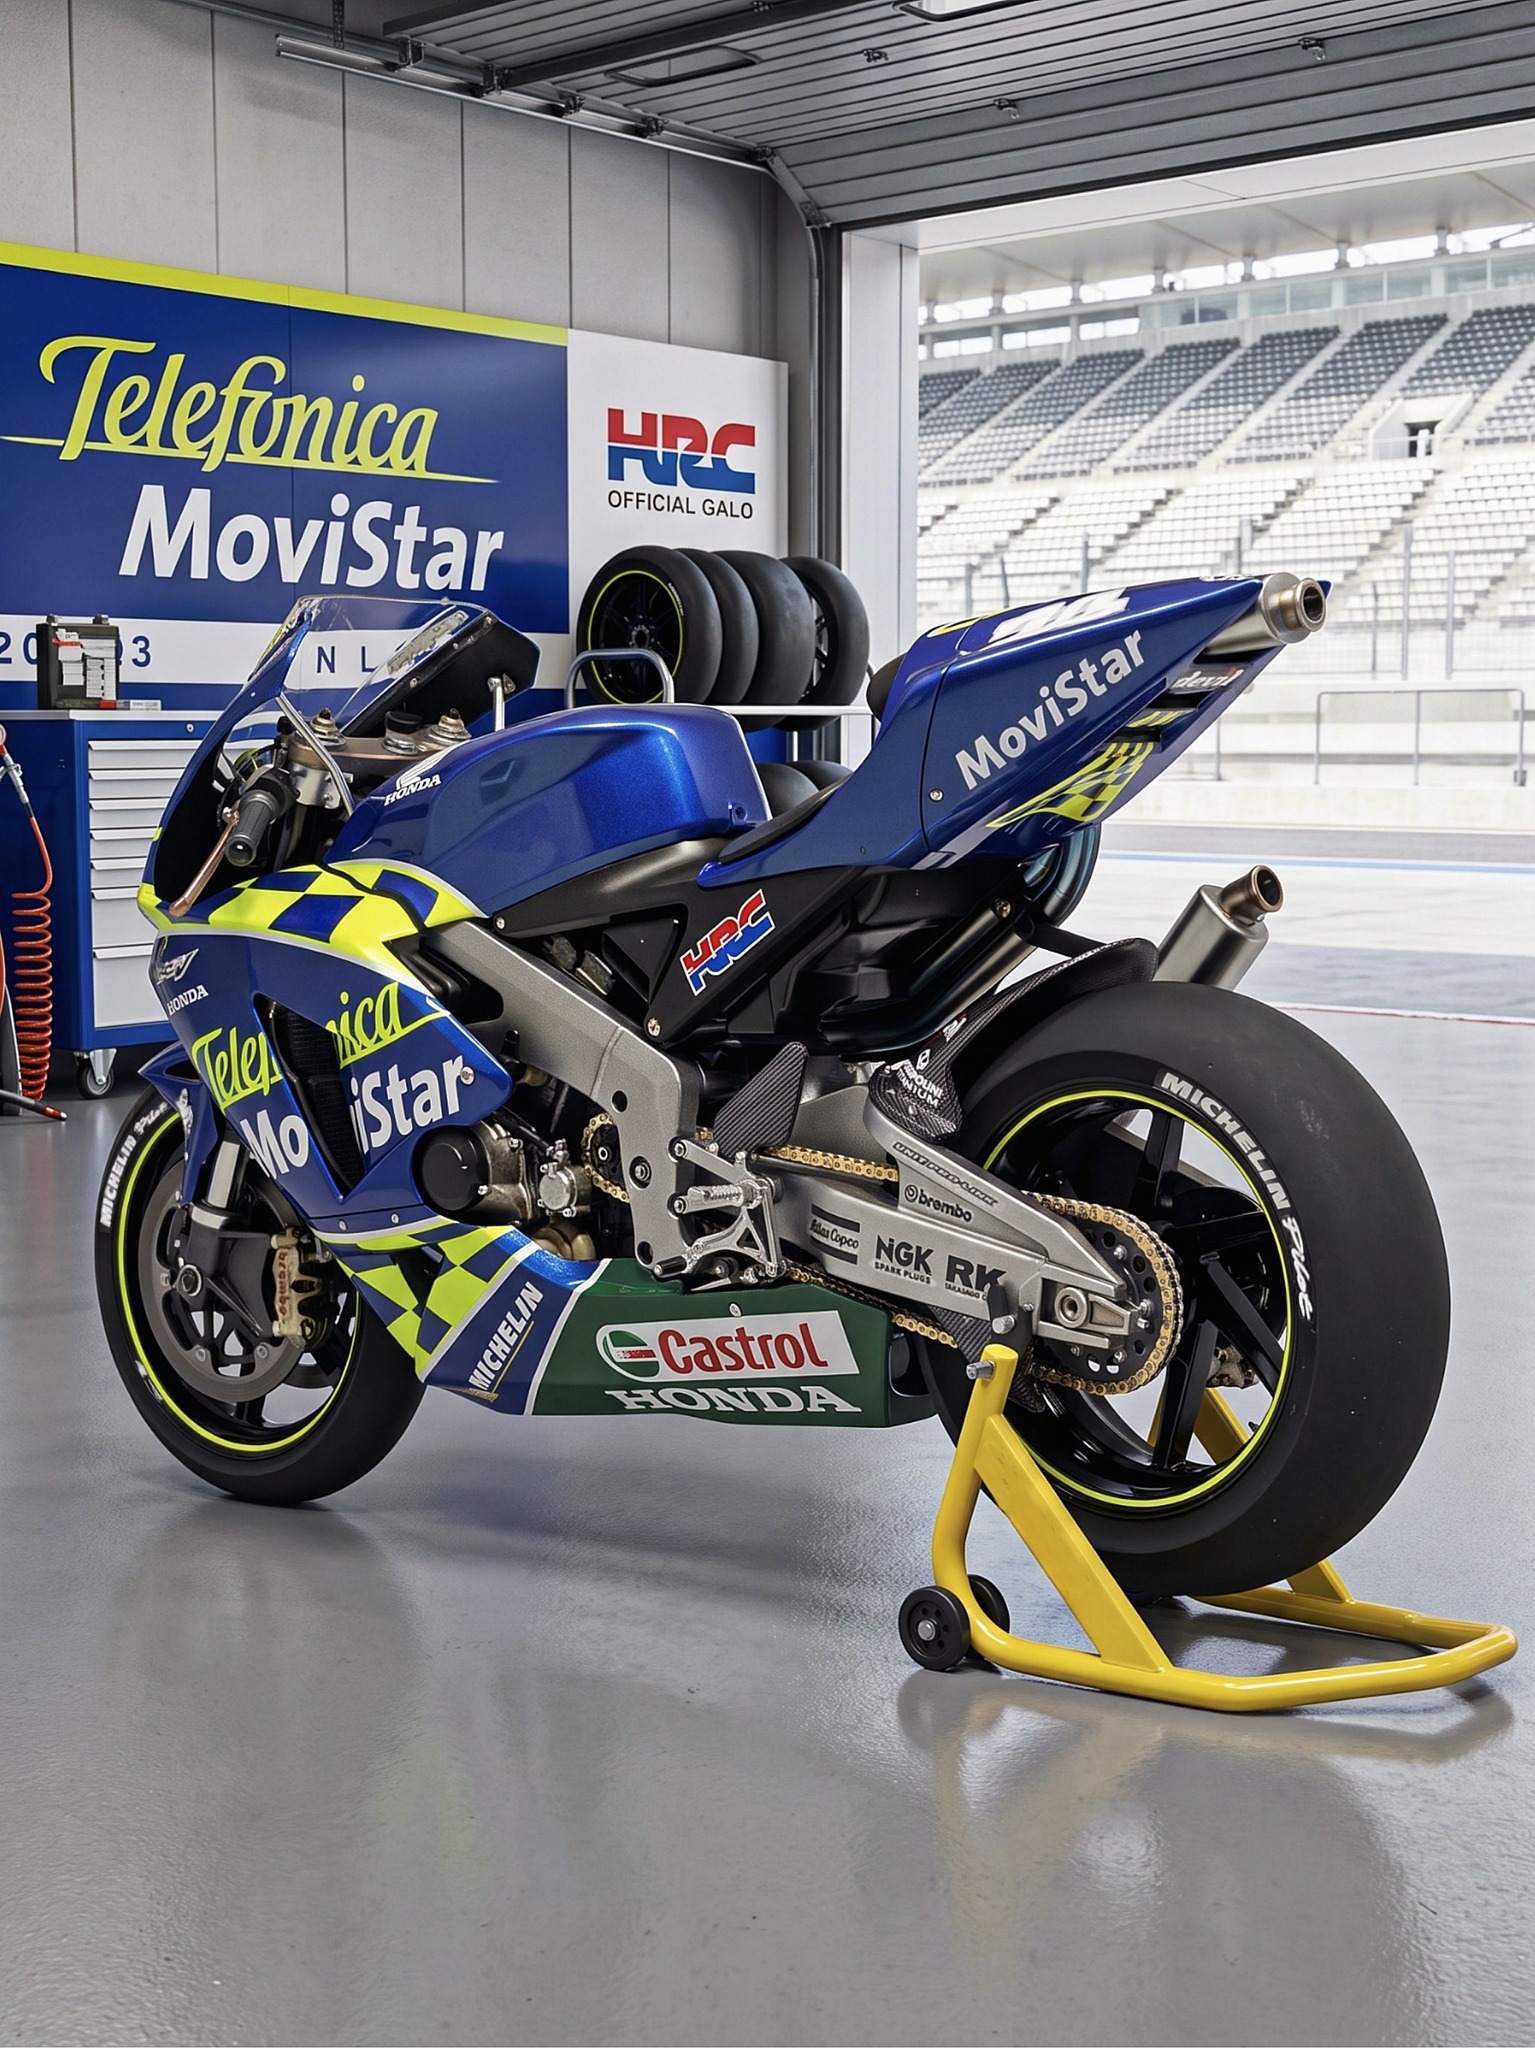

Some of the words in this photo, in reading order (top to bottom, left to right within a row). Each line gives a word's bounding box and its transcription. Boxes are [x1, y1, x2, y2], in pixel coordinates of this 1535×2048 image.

[608, 408, 755, 494] HRC
[608, 490, 695, 514] OFFICIAL
[702, 498, 753, 519] GALO
[119, 484, 504, 591] MoviStar
[955, 630, 1144, 790] MoviStar
[384, 773, 441, 806] HONDA
[680, 888, 775, 996] HRC
[167, 984, 209, 1015] HONDA
[240, 1054, 464, 1181] MoiStar
[1160, 1071, 1291, 1210] MICHELIN
[100, 1134, 137, 1228] MICHELIN
[918, 1188, 972, 1222] brembo
[830, 1228, 859, 1249] Copco
[875, 1234, 934, 1276] NGK
[874, 1261, 901, 1276] SPARK
[903, 1269, 931, 1285] PLUGS
[945, 1254, 1007, 1292] RK
[468, 1281, 544, 1391] MICHELIN
[658, 1322, 829, 1375] Castrol
[604, 1385, 862, 1413] HONDA
